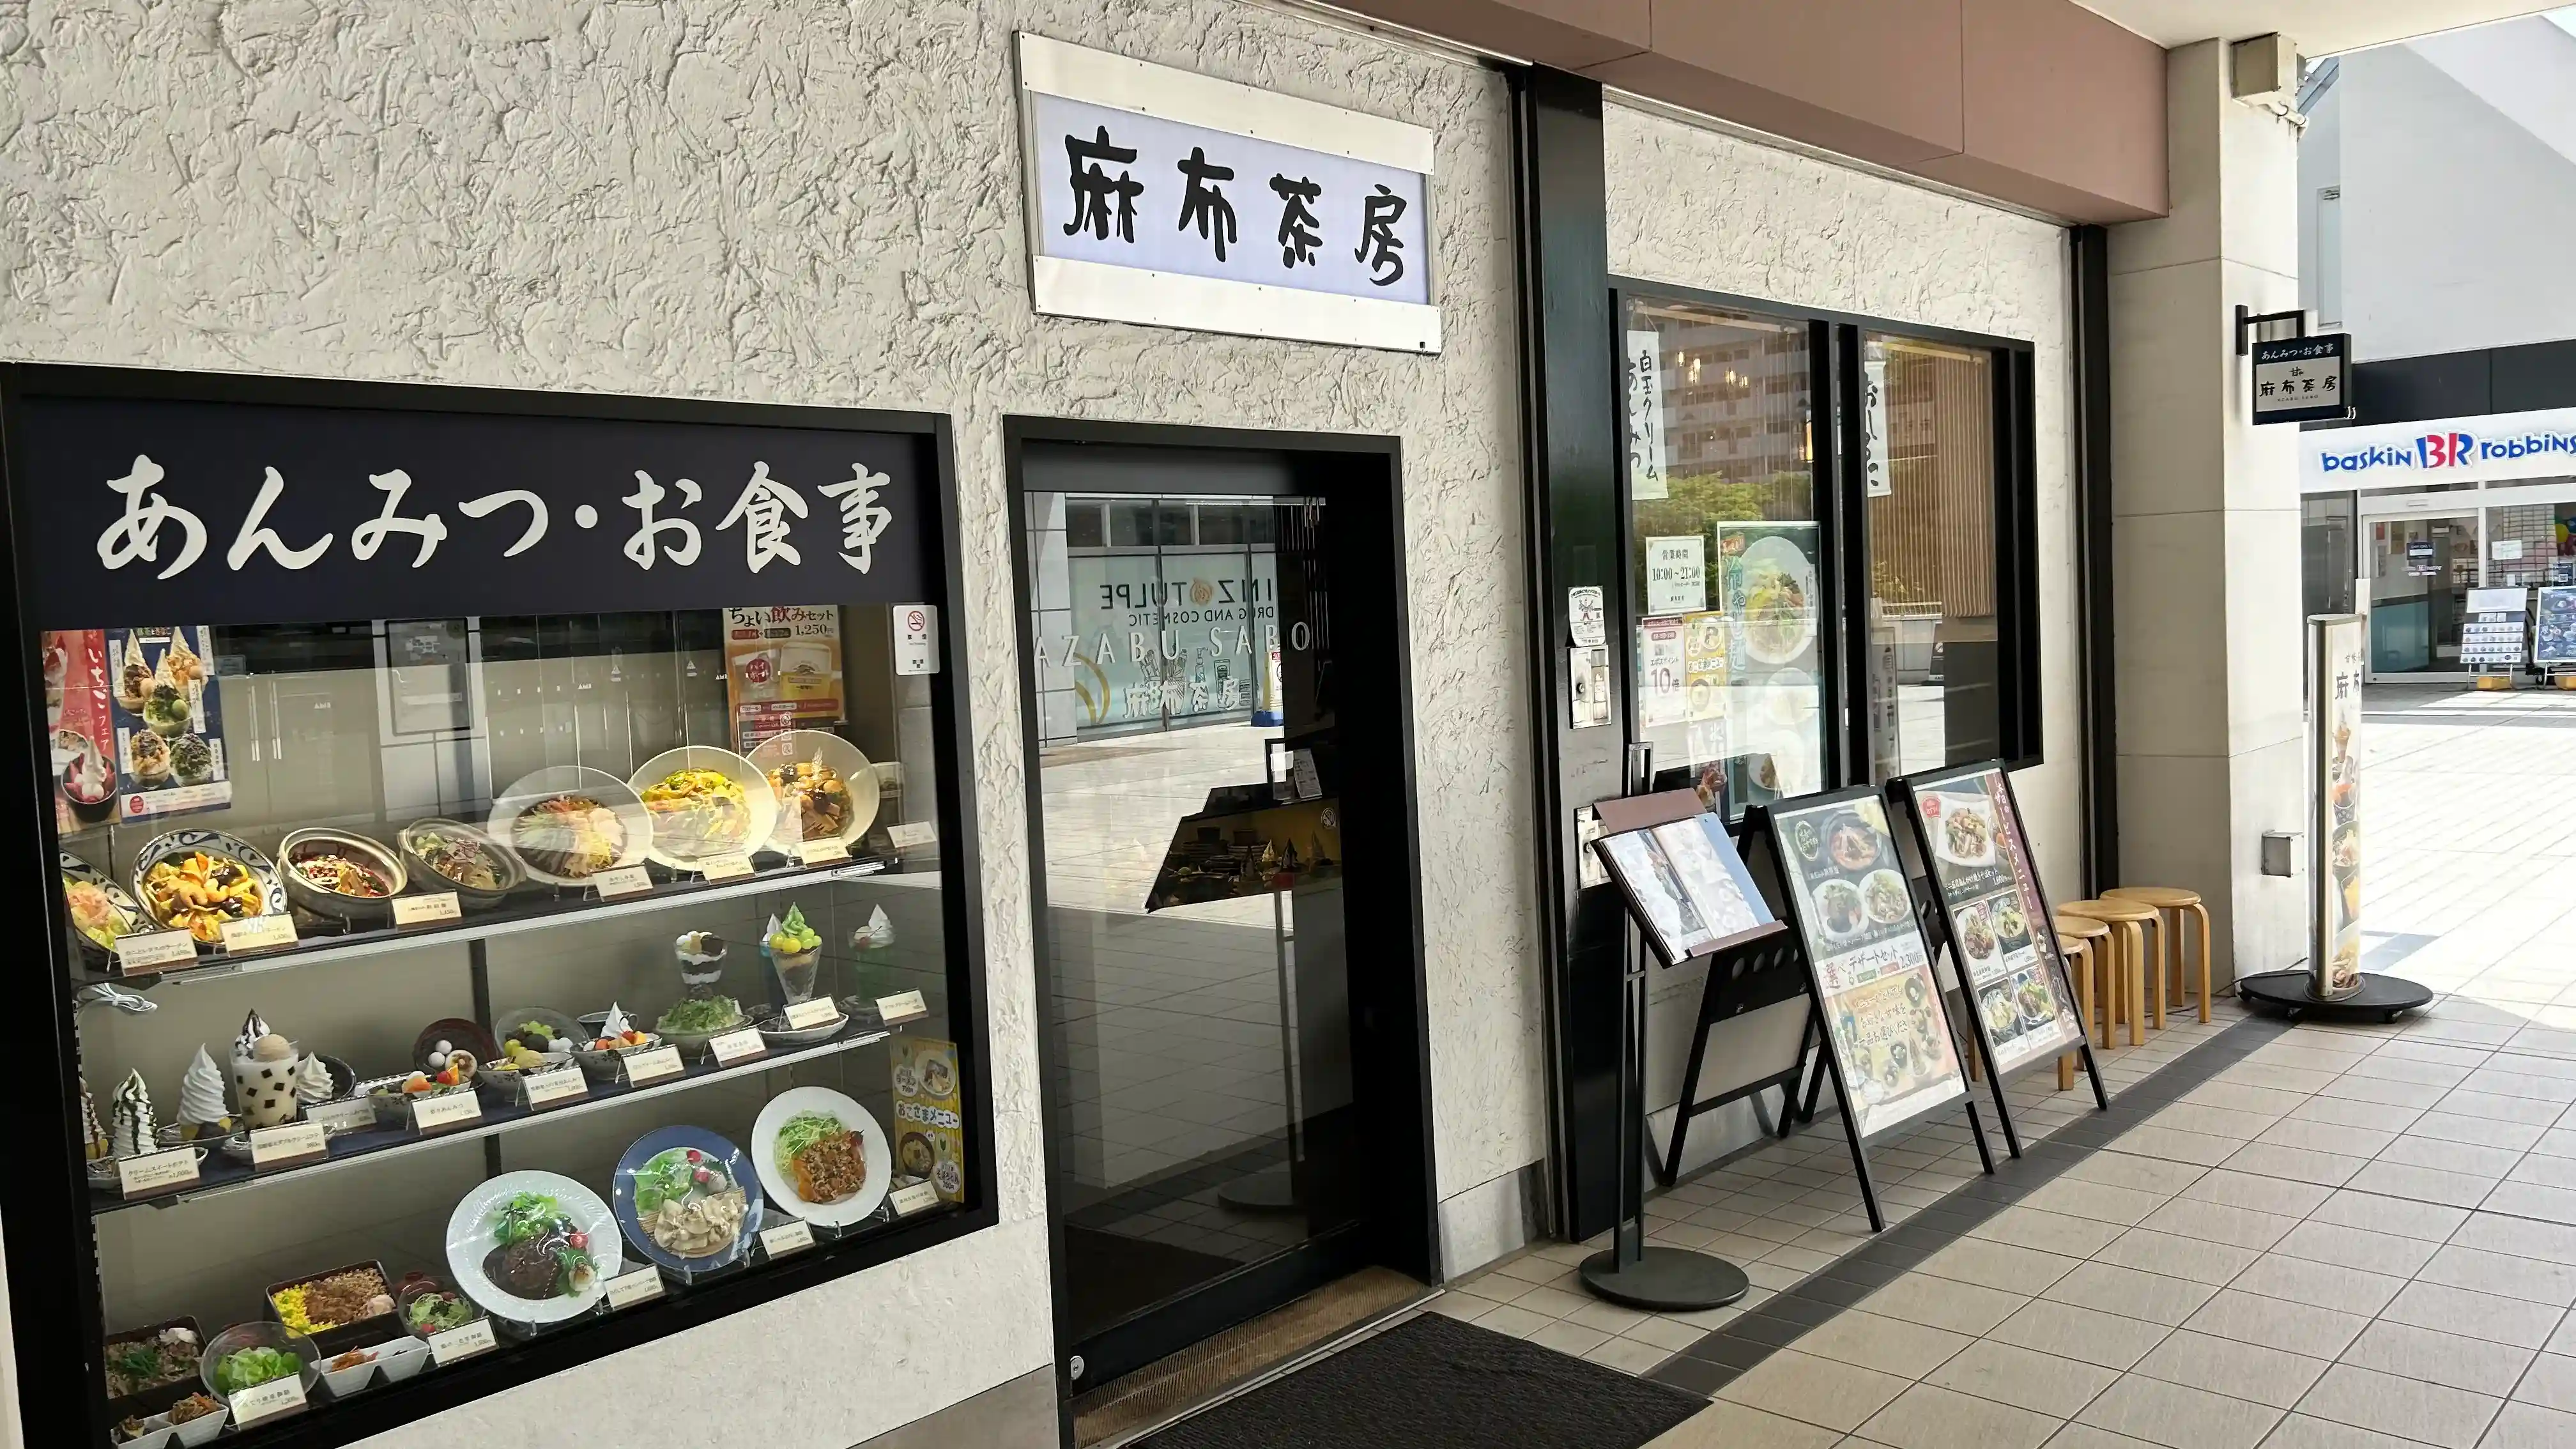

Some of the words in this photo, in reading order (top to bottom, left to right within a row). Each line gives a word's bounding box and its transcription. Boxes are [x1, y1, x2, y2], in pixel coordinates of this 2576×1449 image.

[1064, 126, 1407, 286] 麻布茶房
[2261, 343, 2333, 360] あんみつ・お食事
[2259, 375, 2338, 397] 麻布茶房
[1639, 349, 1659, 482] 白玉クリーム
[2322, 445, 2412, 472] baskin
[2416, 432, 2474, 469] BR
[97, 454, 893, 579] あんみつ・お食事
[1662, 549, 1689, 560] 営業時間
[728, 606, 834, 627] ちょい飲みセット
[1034, 629, 1180, 670] AZABU
[1209, 621, 1310, 657] SABO
[1123, 675, 1240, 719] 麻布茶房
[898, 1103, 958, 1126] おこさまメニュー
